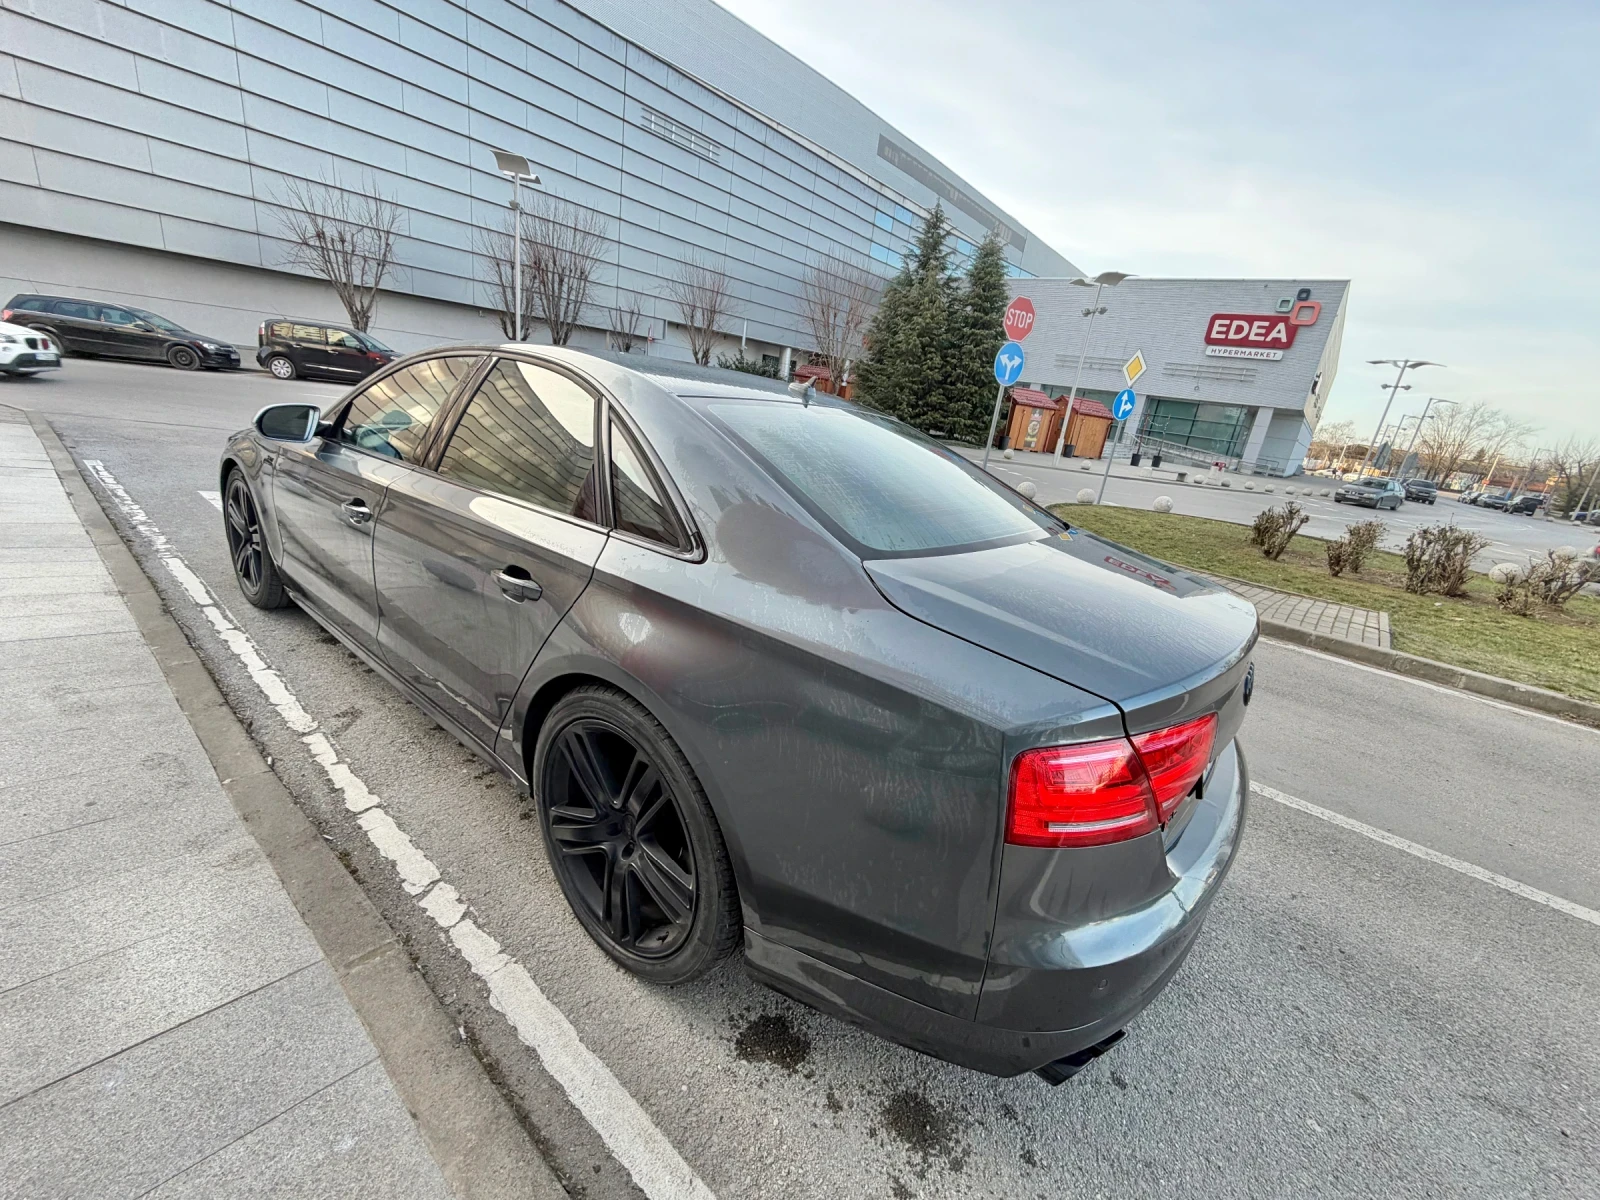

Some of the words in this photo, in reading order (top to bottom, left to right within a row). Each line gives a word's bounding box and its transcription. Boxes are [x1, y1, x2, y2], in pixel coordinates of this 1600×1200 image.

[1006, 308, 1034, 329] STOP
[1210, 319, 1287, 343] EDEA
[1210, 348, 1278, 359] HYPERMARKET
